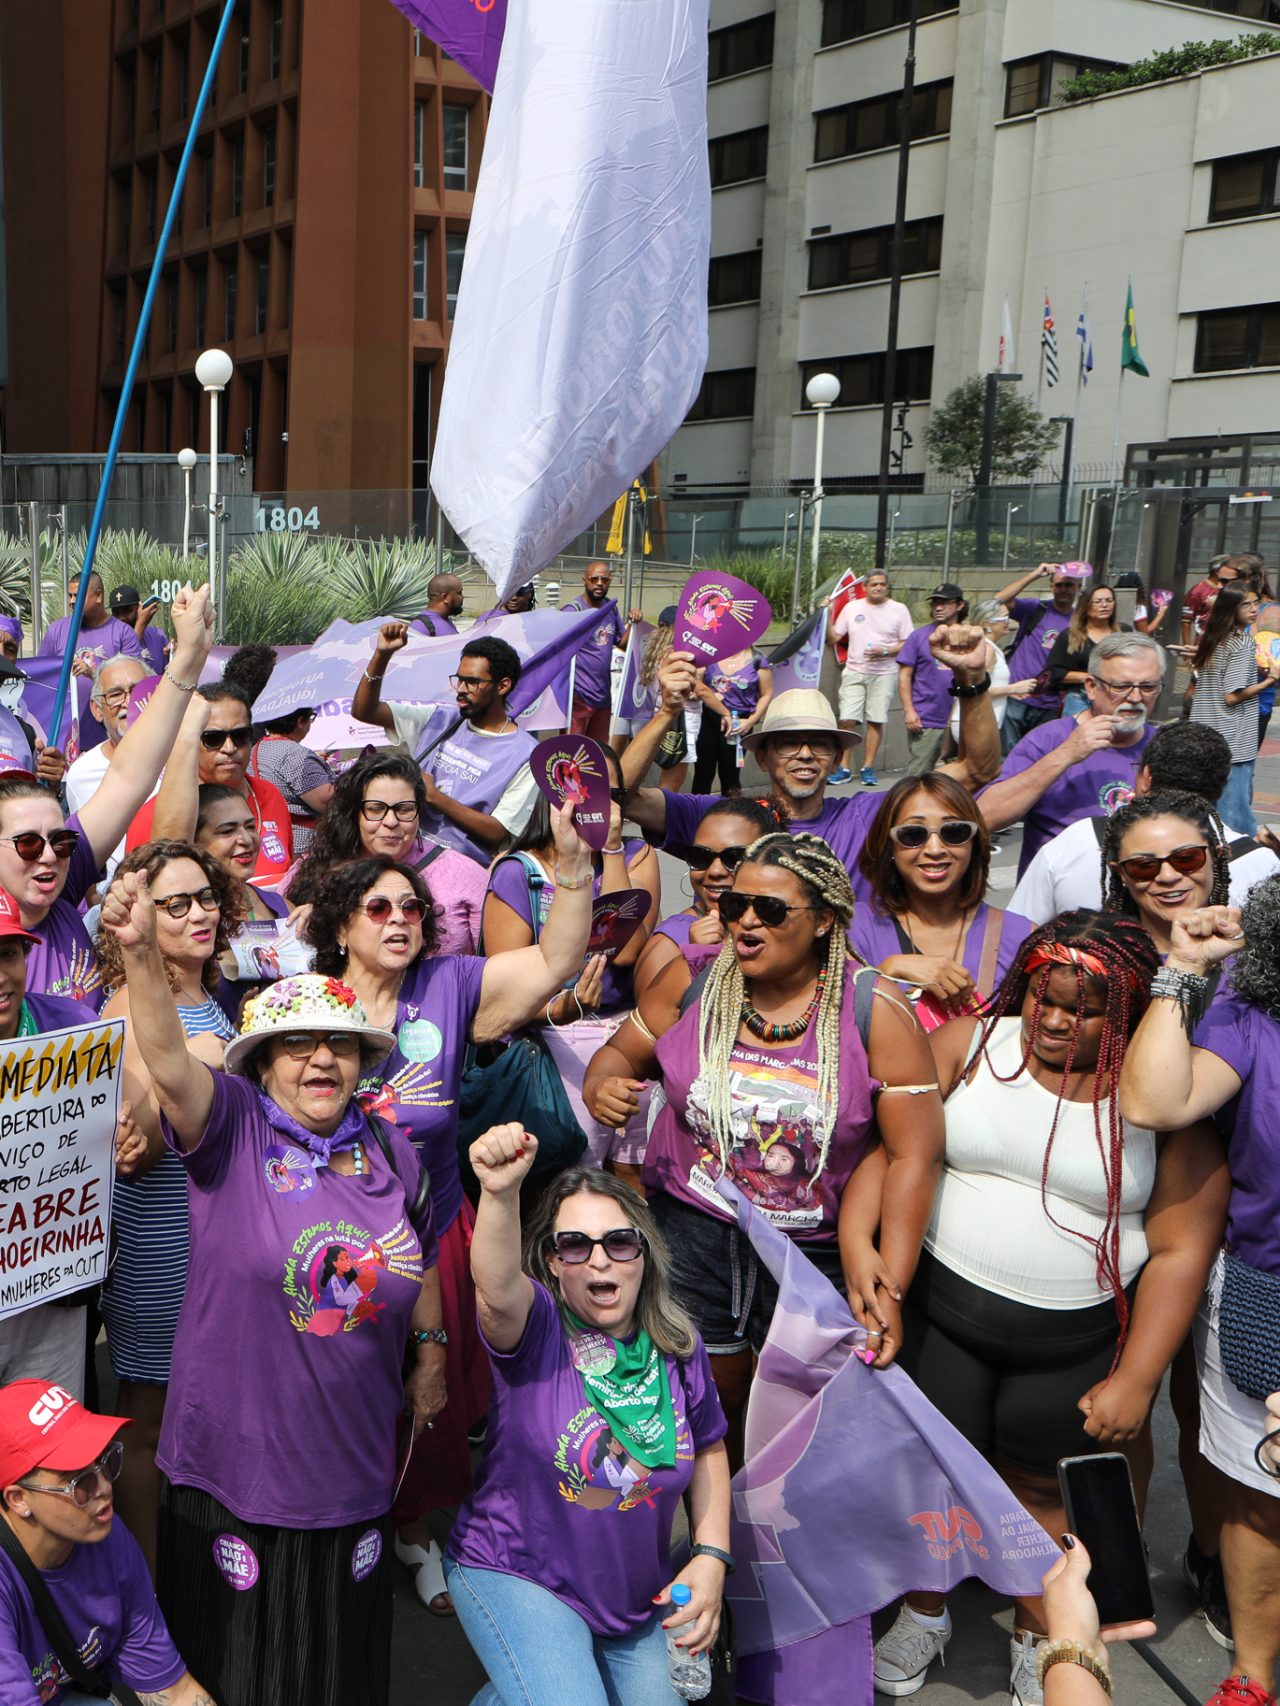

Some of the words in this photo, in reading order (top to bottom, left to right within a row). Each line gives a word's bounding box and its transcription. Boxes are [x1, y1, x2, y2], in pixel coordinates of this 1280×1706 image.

[255, 506, 321, 531] 1804
[91, 1093, 107, 1108] DO
[57, 1129, 78, 1150] DE
[37, 1153, 93, 1188] LEGAL
[301, 1239, 326, 1273] Mulheres
[324, 1235, 335, 1244] na
[335, 1233, 351, 1244] luta
[351, 1239, 366, 1249] por
[0, 1267, 61, 1309] MULHERES
[282, 1257, 298, 1297] Ainda
[572, 1420, 599, 1450] Mulheres
[219, 1538, 247, 1552] CRIANÇA
[220, 1547, 241, 1561] NÃO
[222, 1559, 249, 1577] MÃE
